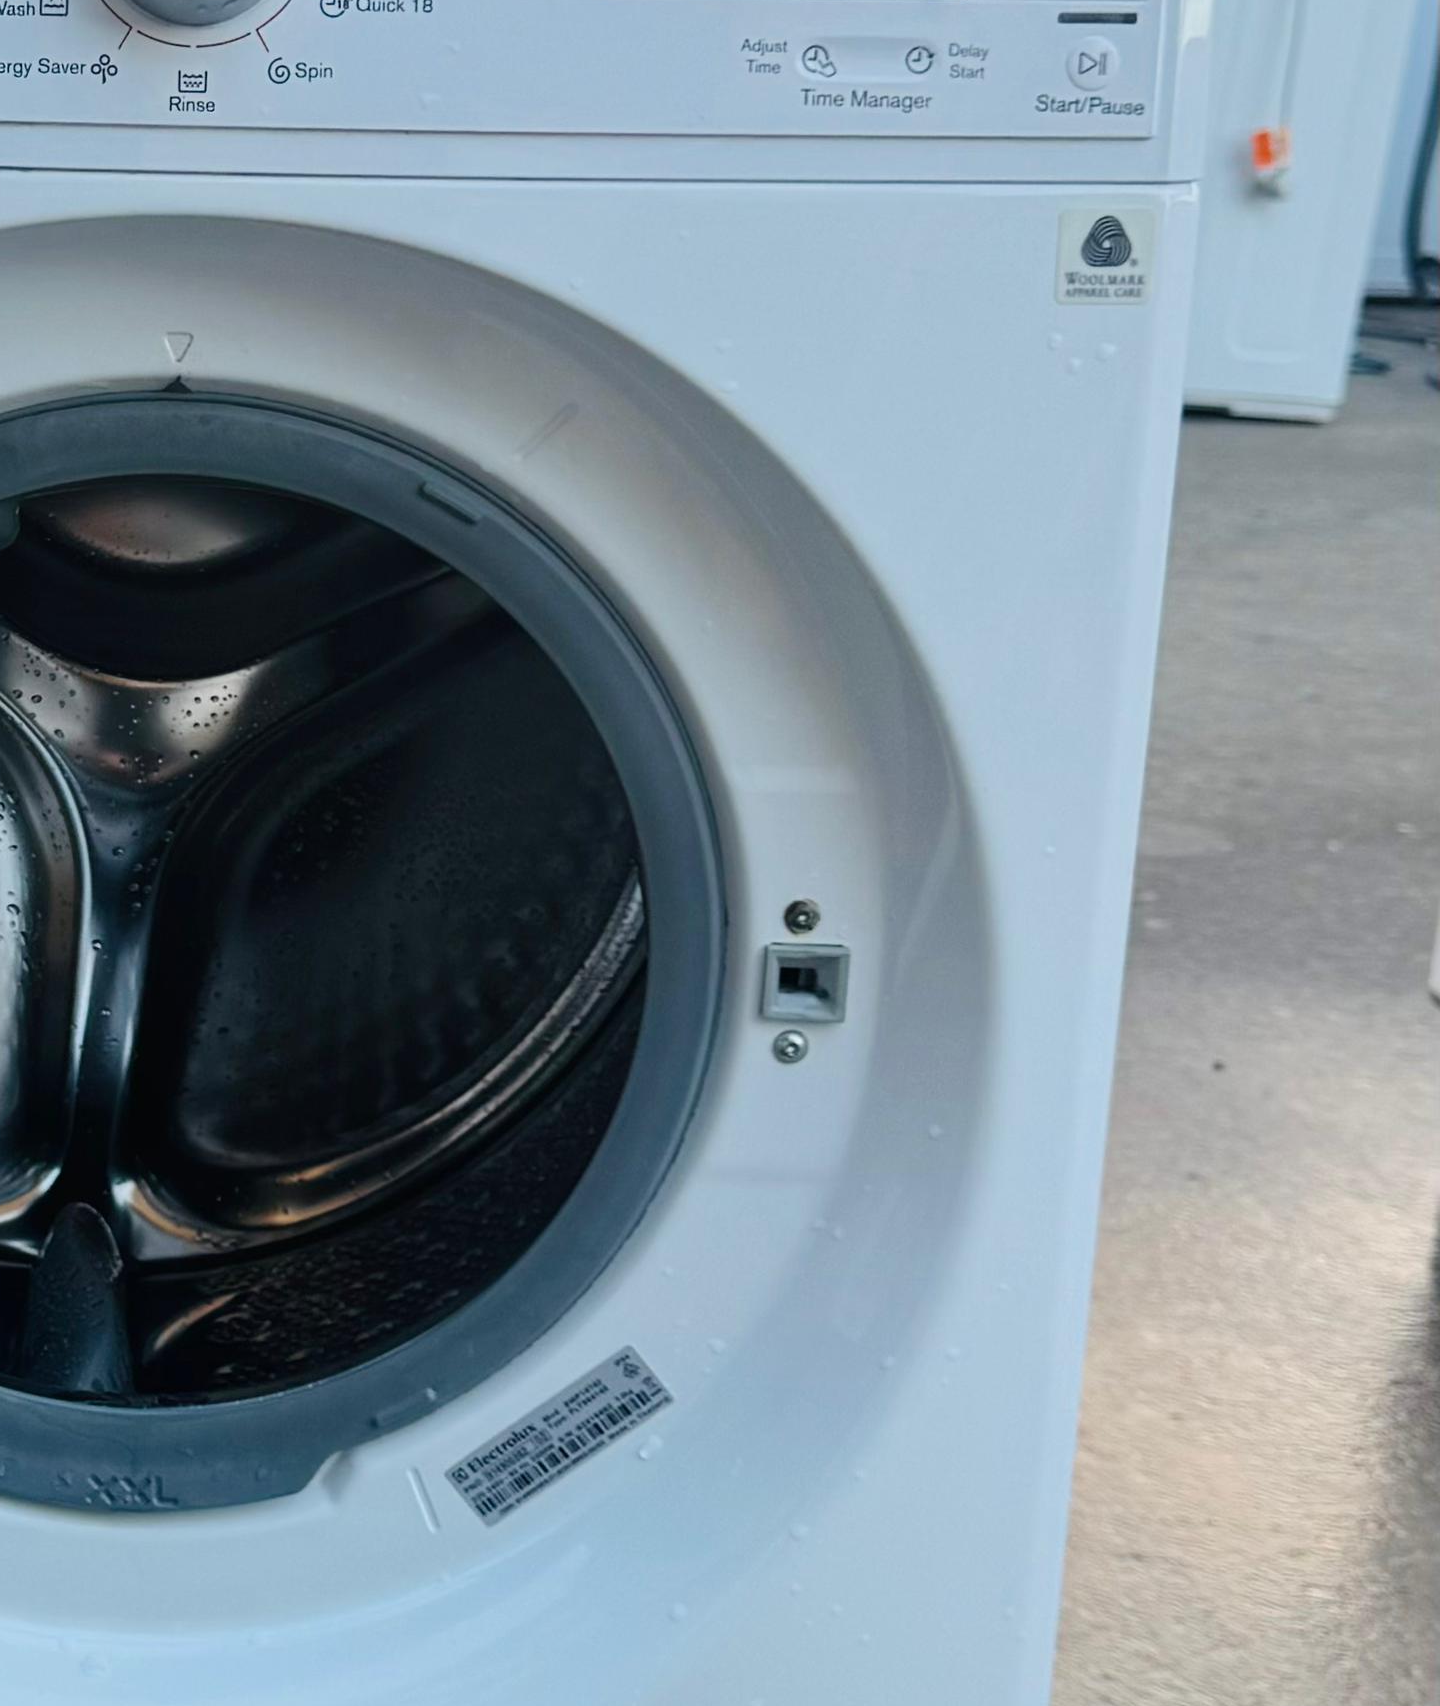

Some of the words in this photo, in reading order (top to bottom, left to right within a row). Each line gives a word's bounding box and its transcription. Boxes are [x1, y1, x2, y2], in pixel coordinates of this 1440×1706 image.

[741, 39, 787, 56] Adjust
[948, 43, 989, 61] Delay
[38, 58, 86, 74] Saver
[295, 62, 333, 82] Spin
[746, 59, 781, 74] Time
[949, 64, 984, 79] Start
[169, 96, 215, 112] Rinse
[801, 89, 844, 107] Time
[851, 90, 932, 113] Manager
[1035, 94, 1145, 116] Start/Pause
[1064, 271, 1145, 285] WOOLMARK
[1114, 288, 1143, 298] CARE
[467, 1424, 537, 1474] Electrolux
